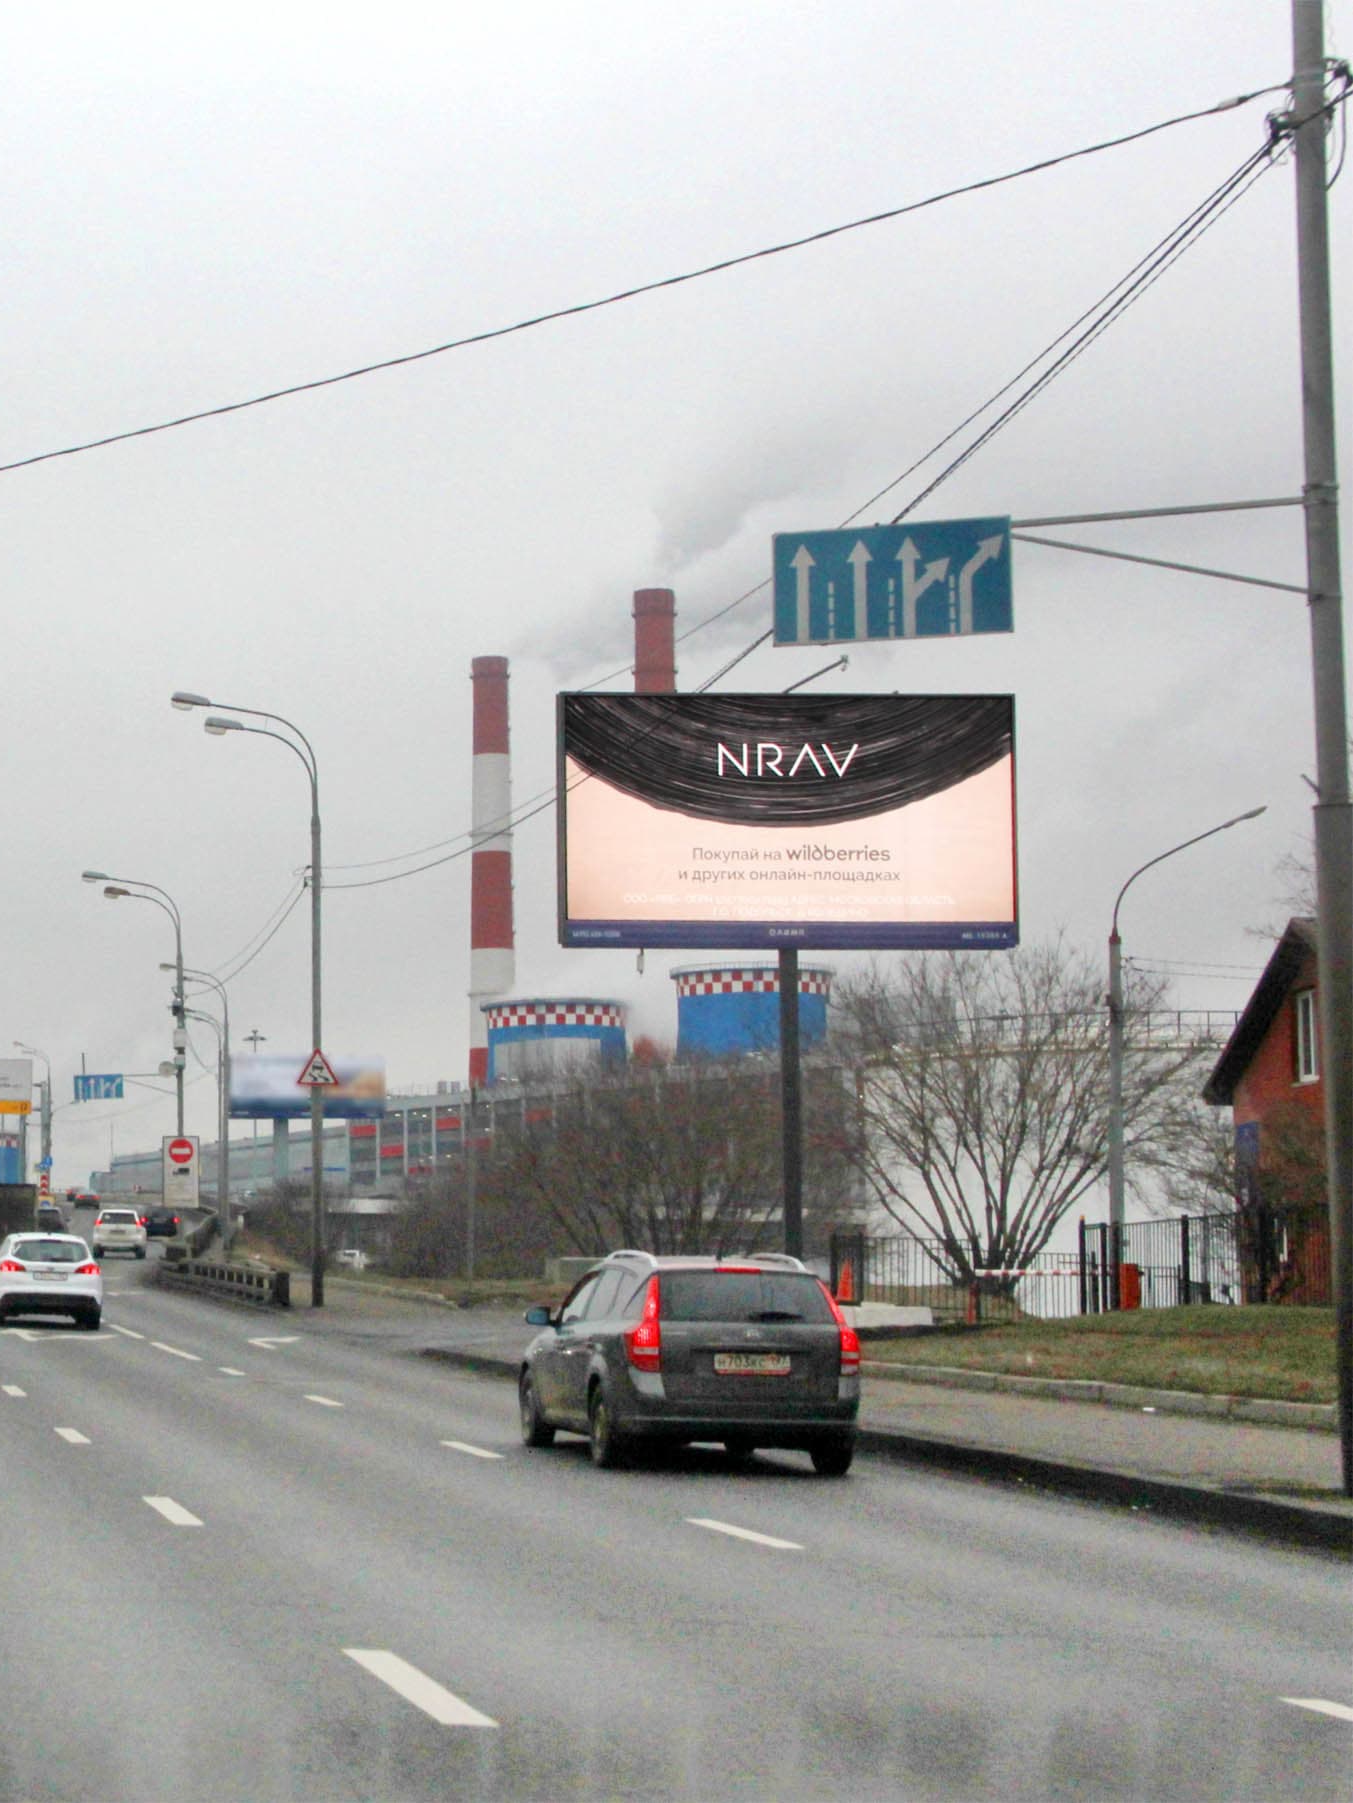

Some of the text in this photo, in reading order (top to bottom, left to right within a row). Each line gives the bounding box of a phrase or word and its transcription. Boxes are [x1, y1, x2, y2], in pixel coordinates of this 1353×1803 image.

[717, 742, 859, 777] NRAV
[692, 844, 891, 864] Покупай на wildberries
[678, 867, 901, 884] и других онлайн-площадках
